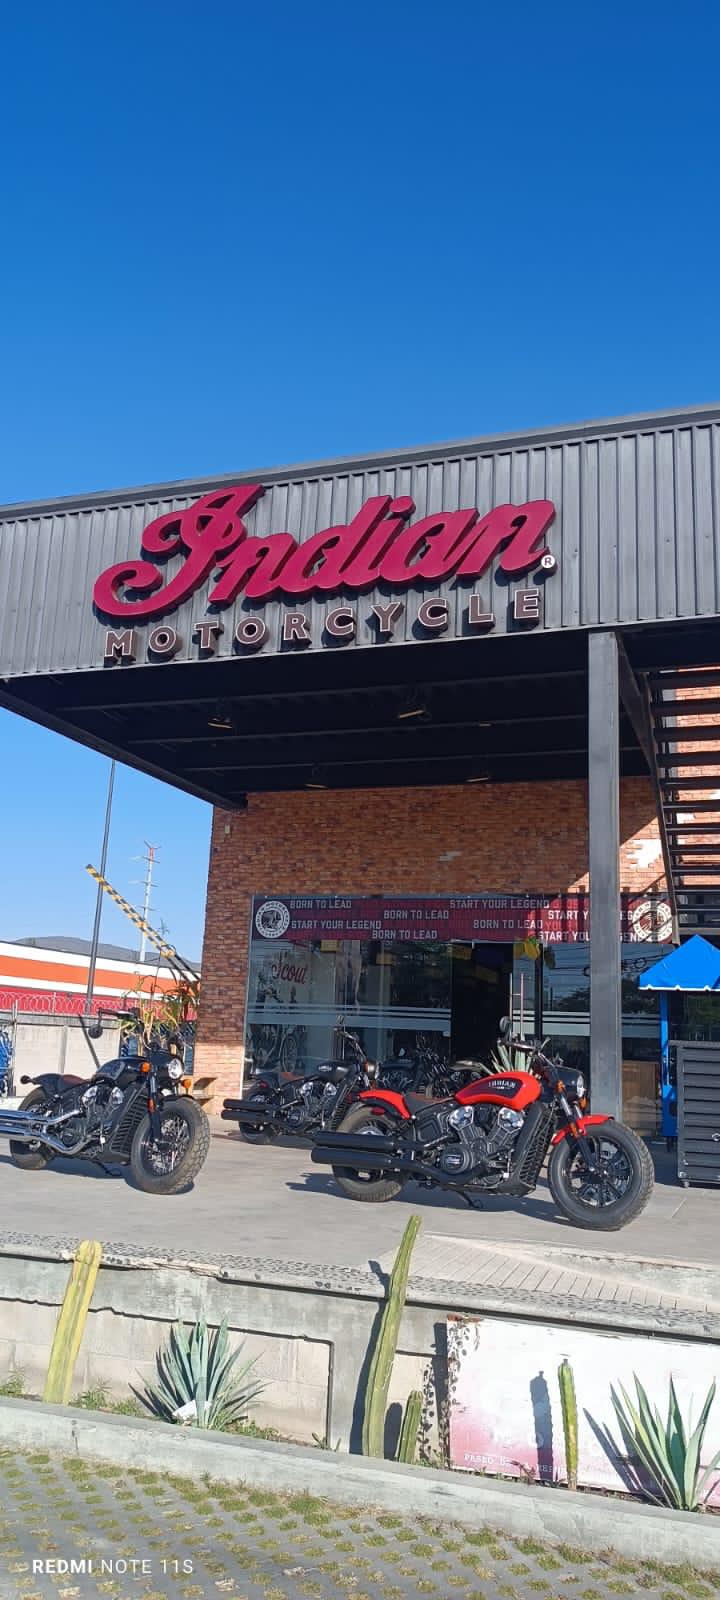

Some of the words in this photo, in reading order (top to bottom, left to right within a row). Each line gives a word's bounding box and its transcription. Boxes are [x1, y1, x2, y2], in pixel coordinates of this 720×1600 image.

[93, 484, 556, 616] Indian
[104, 588, 541, 660] MOTORCYCLE
[290, 899, 313, 909] BORN
[315, 899, 326, 909] TO
[328, 900, 352, 909] LEAD
[450, 900, 479, 909] START
[482, 900, 507, 909] YOUR
[511, 900, 550, 909] LEGEND
[383, 910, 408, 920] BORN
[411, 911, 423, 920] TO
[425, 910, 449, 920] LEAD
[548, 910, 579, 920] START
[291, 920, 318, 929] START
[320, 920, 344, 929] YOUR
[346, 920, 382, 930] LEGEND
[473, 919, 499, 929] BORN
[502, 919, 514, 929] TO
[517, 919, 543, 929] LEAD
[372, 930, 397, 940] BORN
[399, 930, 411, 939] TO
[413, 930, 438, 940] LEAD
[538, 931, 570, 941] START
